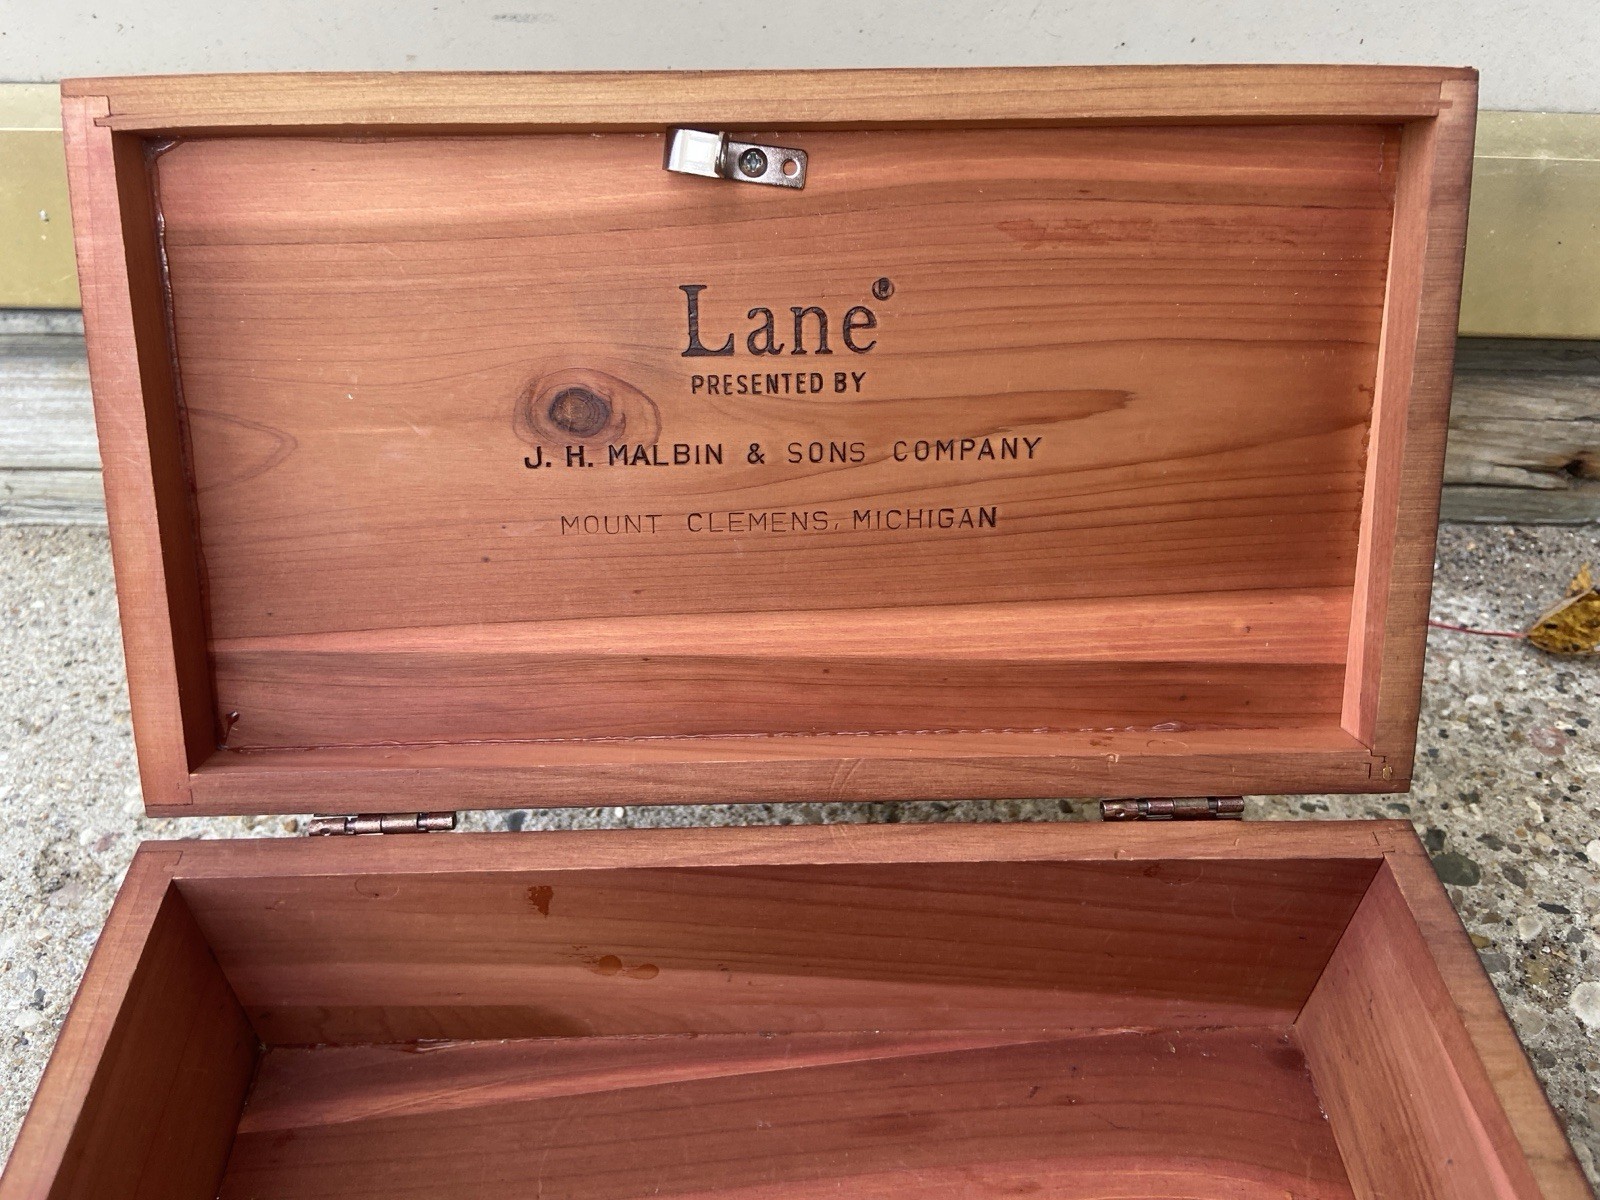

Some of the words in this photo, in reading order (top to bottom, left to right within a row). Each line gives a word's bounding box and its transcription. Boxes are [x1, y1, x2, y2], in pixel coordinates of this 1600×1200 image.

[691, 371, 824, 396] PRESENTED
[834, 371, 867, 394] BY
[524, 445, 552, 470] J.
[566, 445, 594, 469] H.
[608, 443, 724, 467] MALBIN
[747, 443, 766, 465] &
[788, 441, 866, 464] SONS
[893, 436, 1043, 463] COMPANY
[561, 513, 663, 536] MOUNT
[687, 510, 839, 534] CLEMENS,
[853, 506, 999, 531] MICHIGAN
